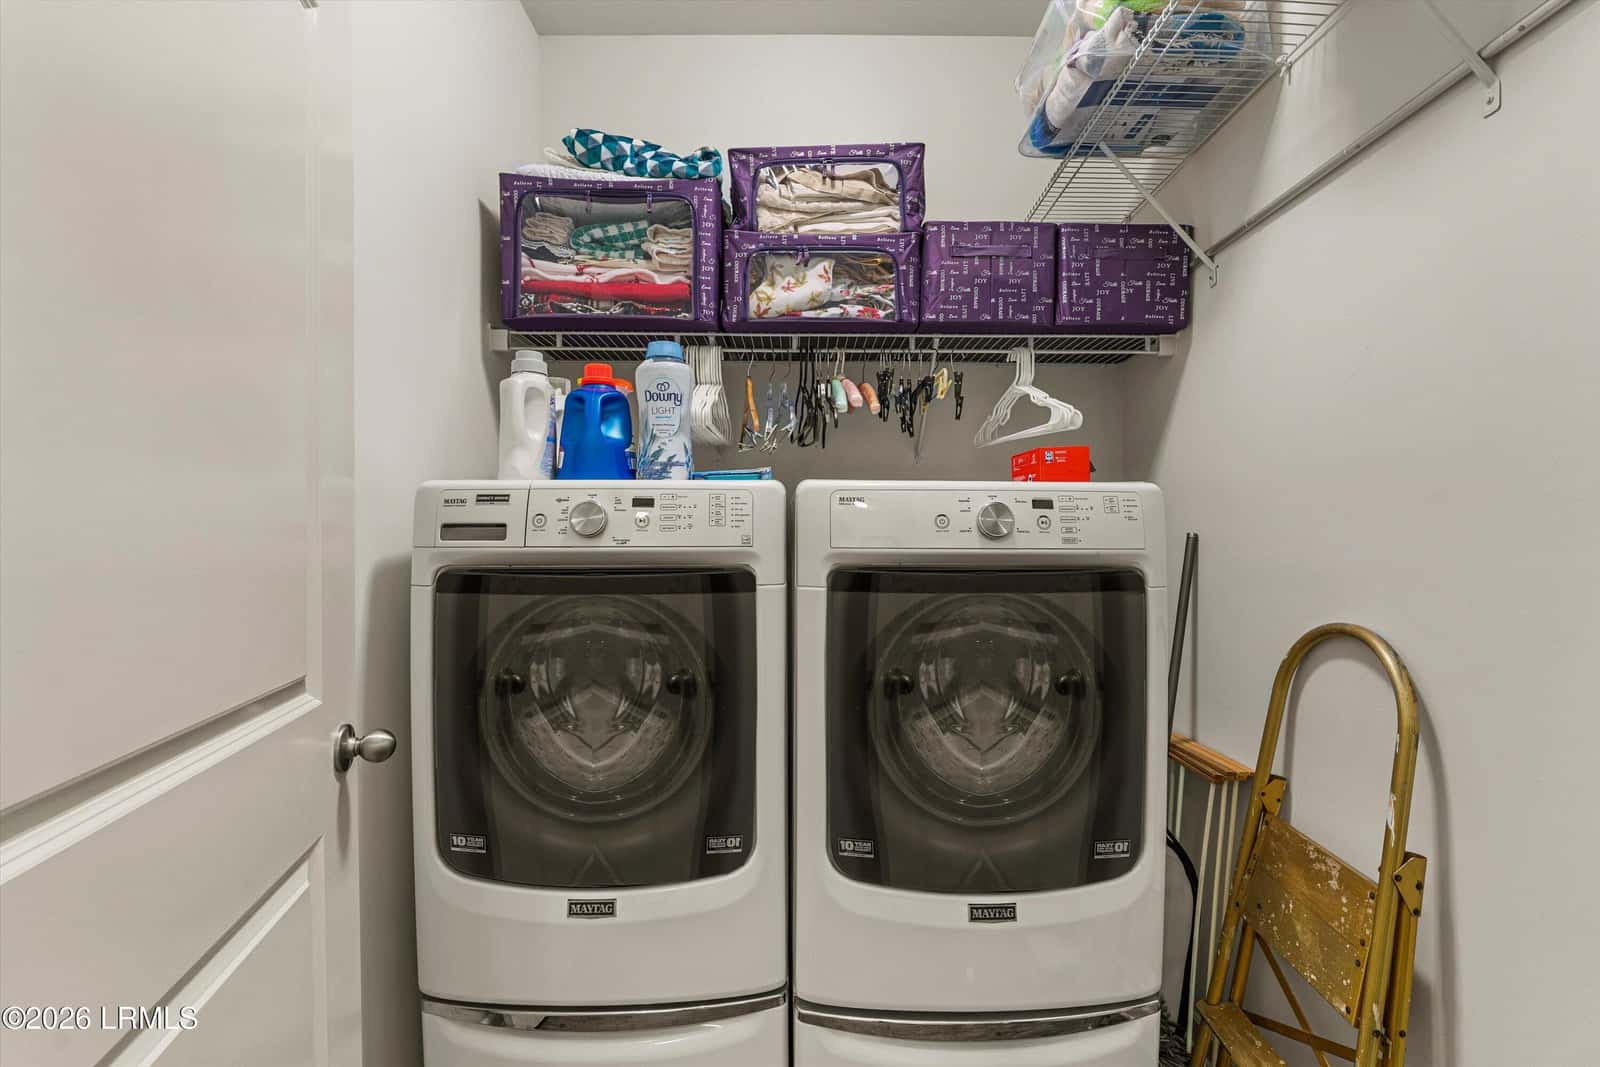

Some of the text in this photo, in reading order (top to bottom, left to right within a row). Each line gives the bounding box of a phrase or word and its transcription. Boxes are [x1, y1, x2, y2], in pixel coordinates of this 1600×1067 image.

[645, 390, 683, 406] Downy
[651, 406, 676, 415] LIGHT
[452, 836, 466, 847] 10
[840, 840, 854, 851] 10
[570, 903, 613, 914] MAYTAG
[971, 907, 1014, 919] MAYTAG
